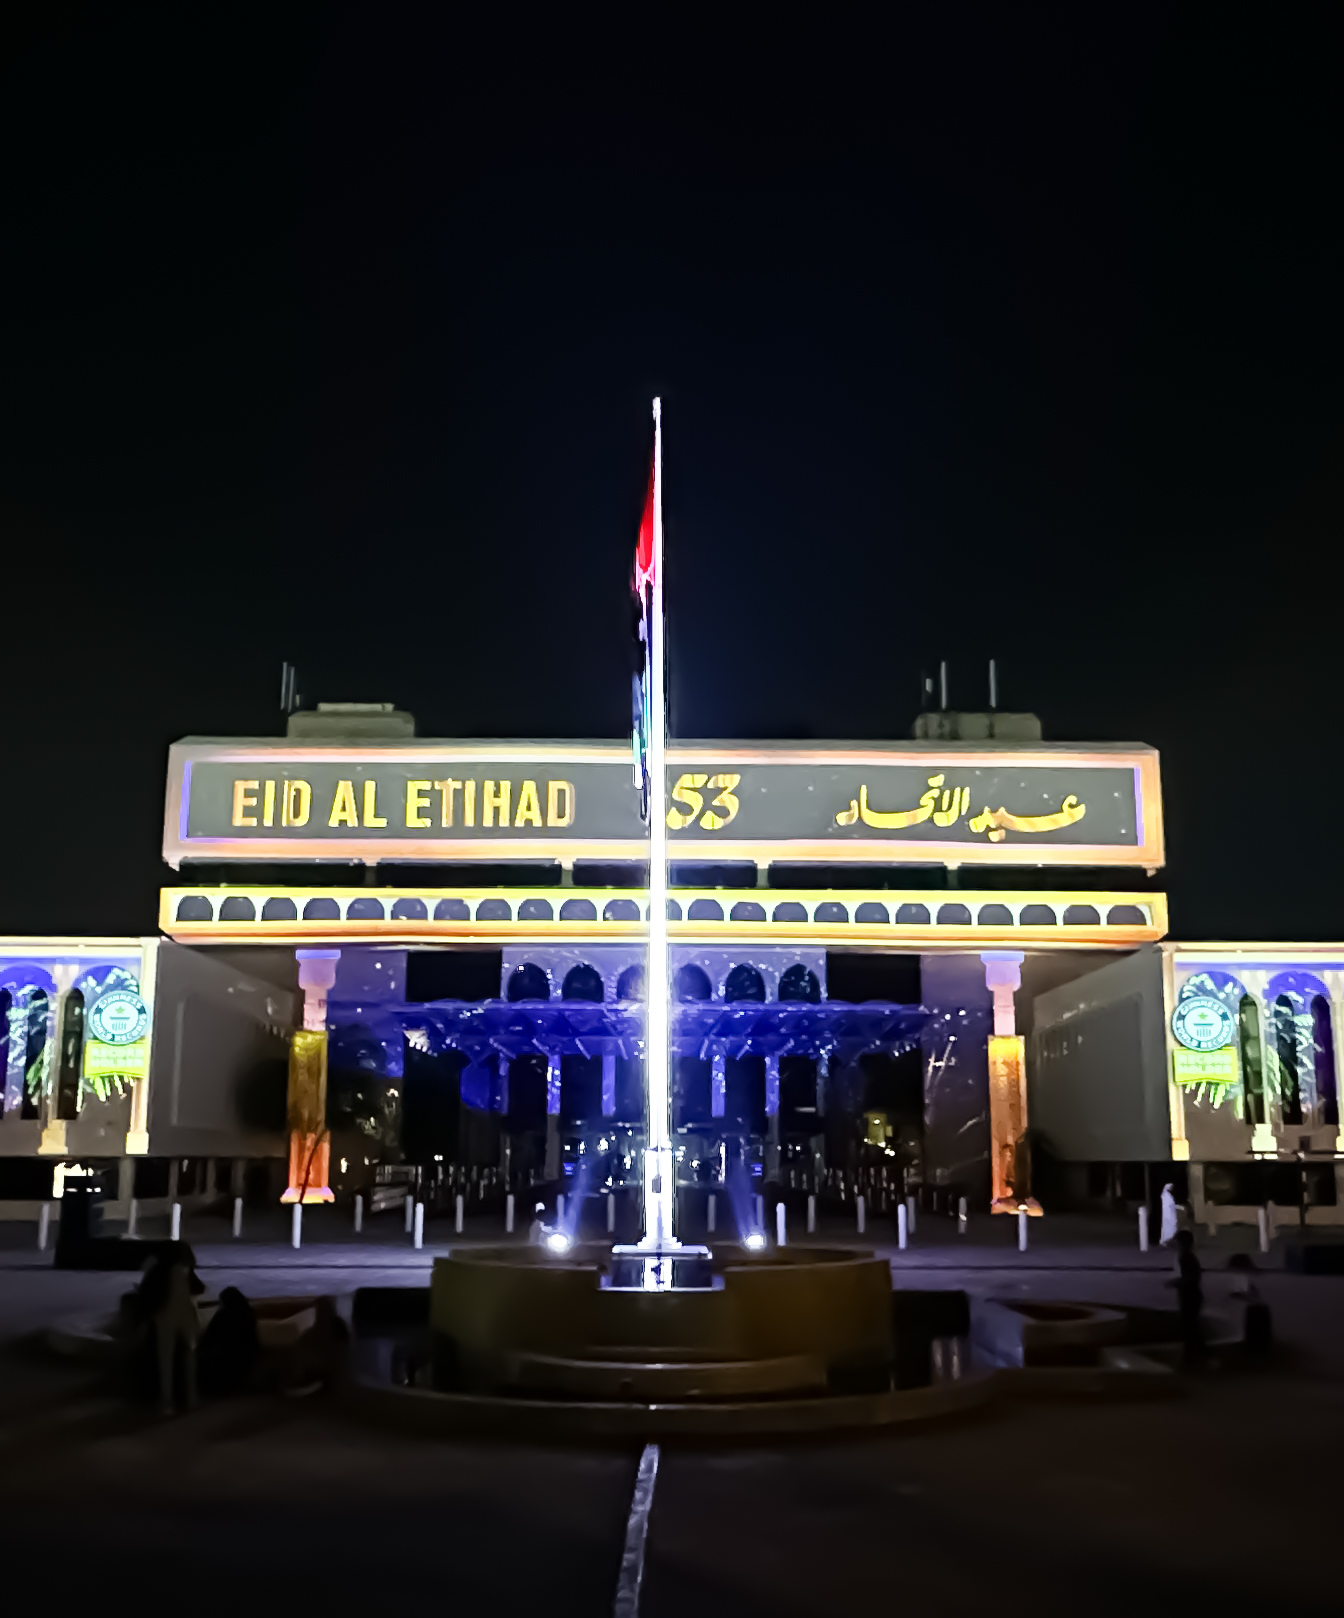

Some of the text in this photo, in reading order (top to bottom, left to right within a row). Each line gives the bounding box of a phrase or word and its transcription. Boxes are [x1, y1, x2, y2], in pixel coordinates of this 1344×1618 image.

[232, 778, 576, 828] EID AL ETIHAD
[665, 773, 741, 830] 53
[969, 795, 1086, 842] عيد
